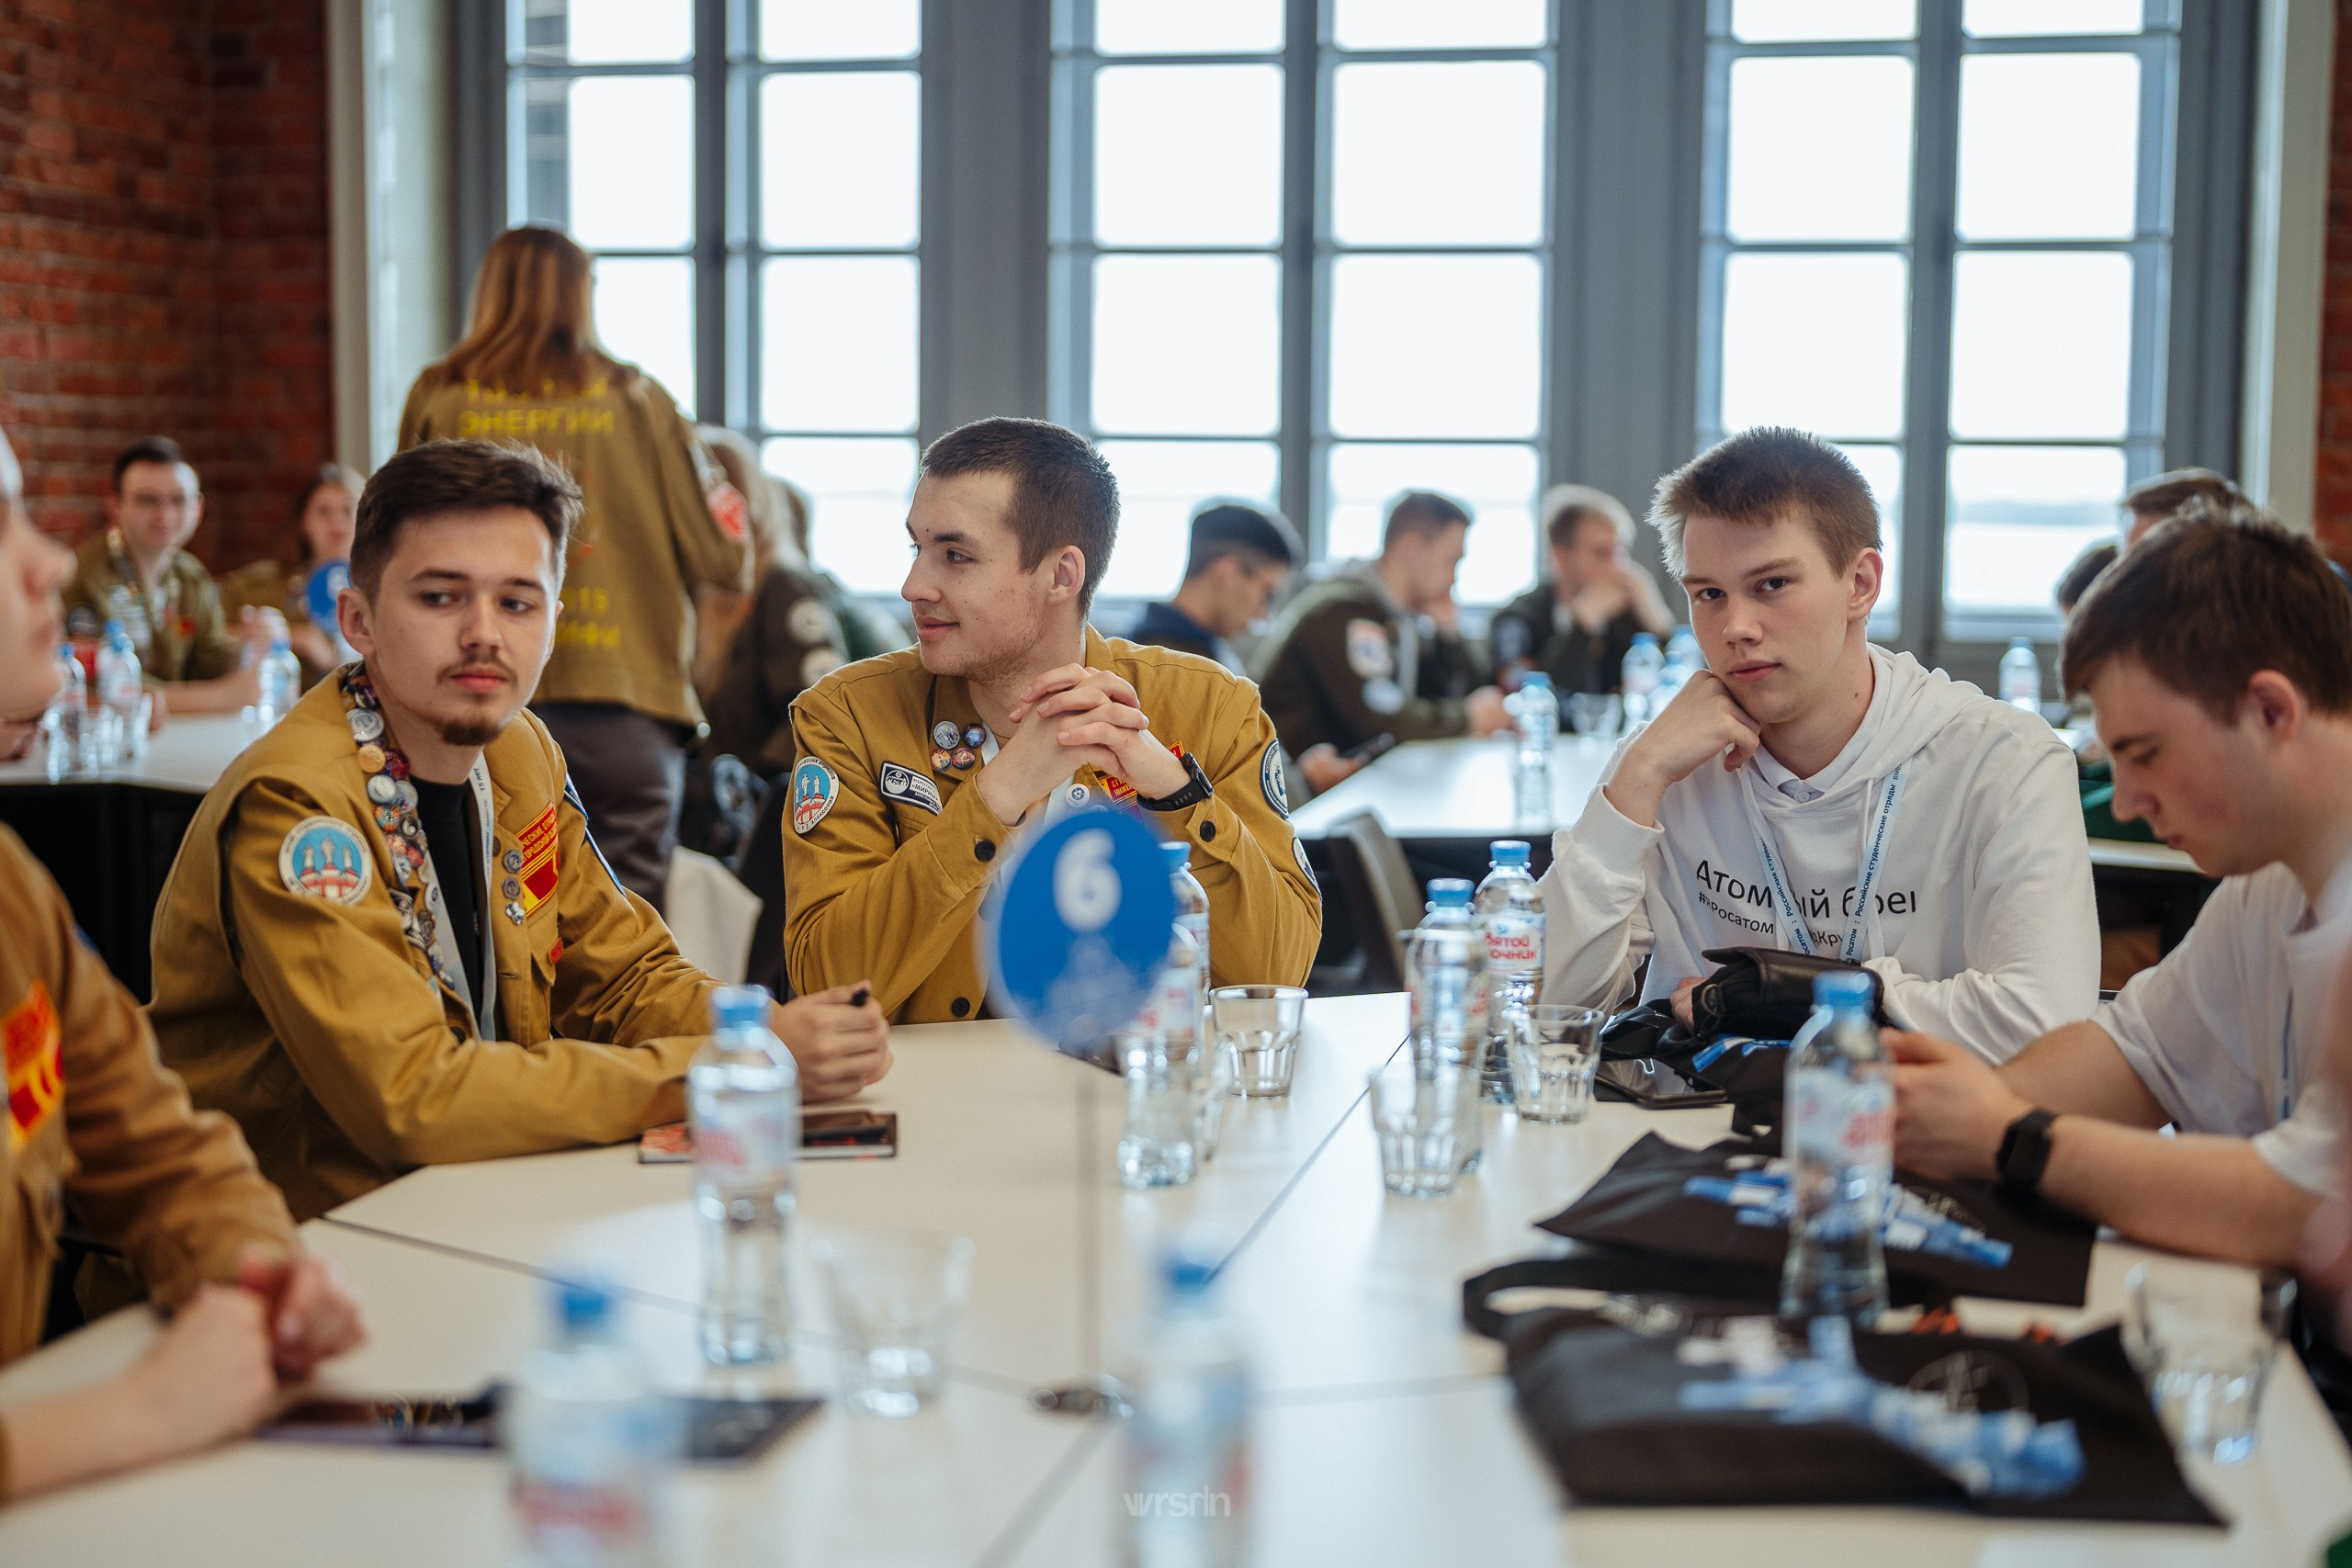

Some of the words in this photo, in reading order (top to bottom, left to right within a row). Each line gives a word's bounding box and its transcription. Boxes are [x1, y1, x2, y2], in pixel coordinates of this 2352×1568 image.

[460, 408, 615, 437] ЭНЕРГИИ
[1855, 870, 1873, 917] Российские
[1869, 815, 1887, 871] студенческие
[1883, 784, 1896, 814] отряды
[1052, 828, 1123, 932] 6
[1696, 859, 1830, 919] Атомый
[1771, 872, 1793, 917] Российские
[1794, 927, 1810, 955] осатом
